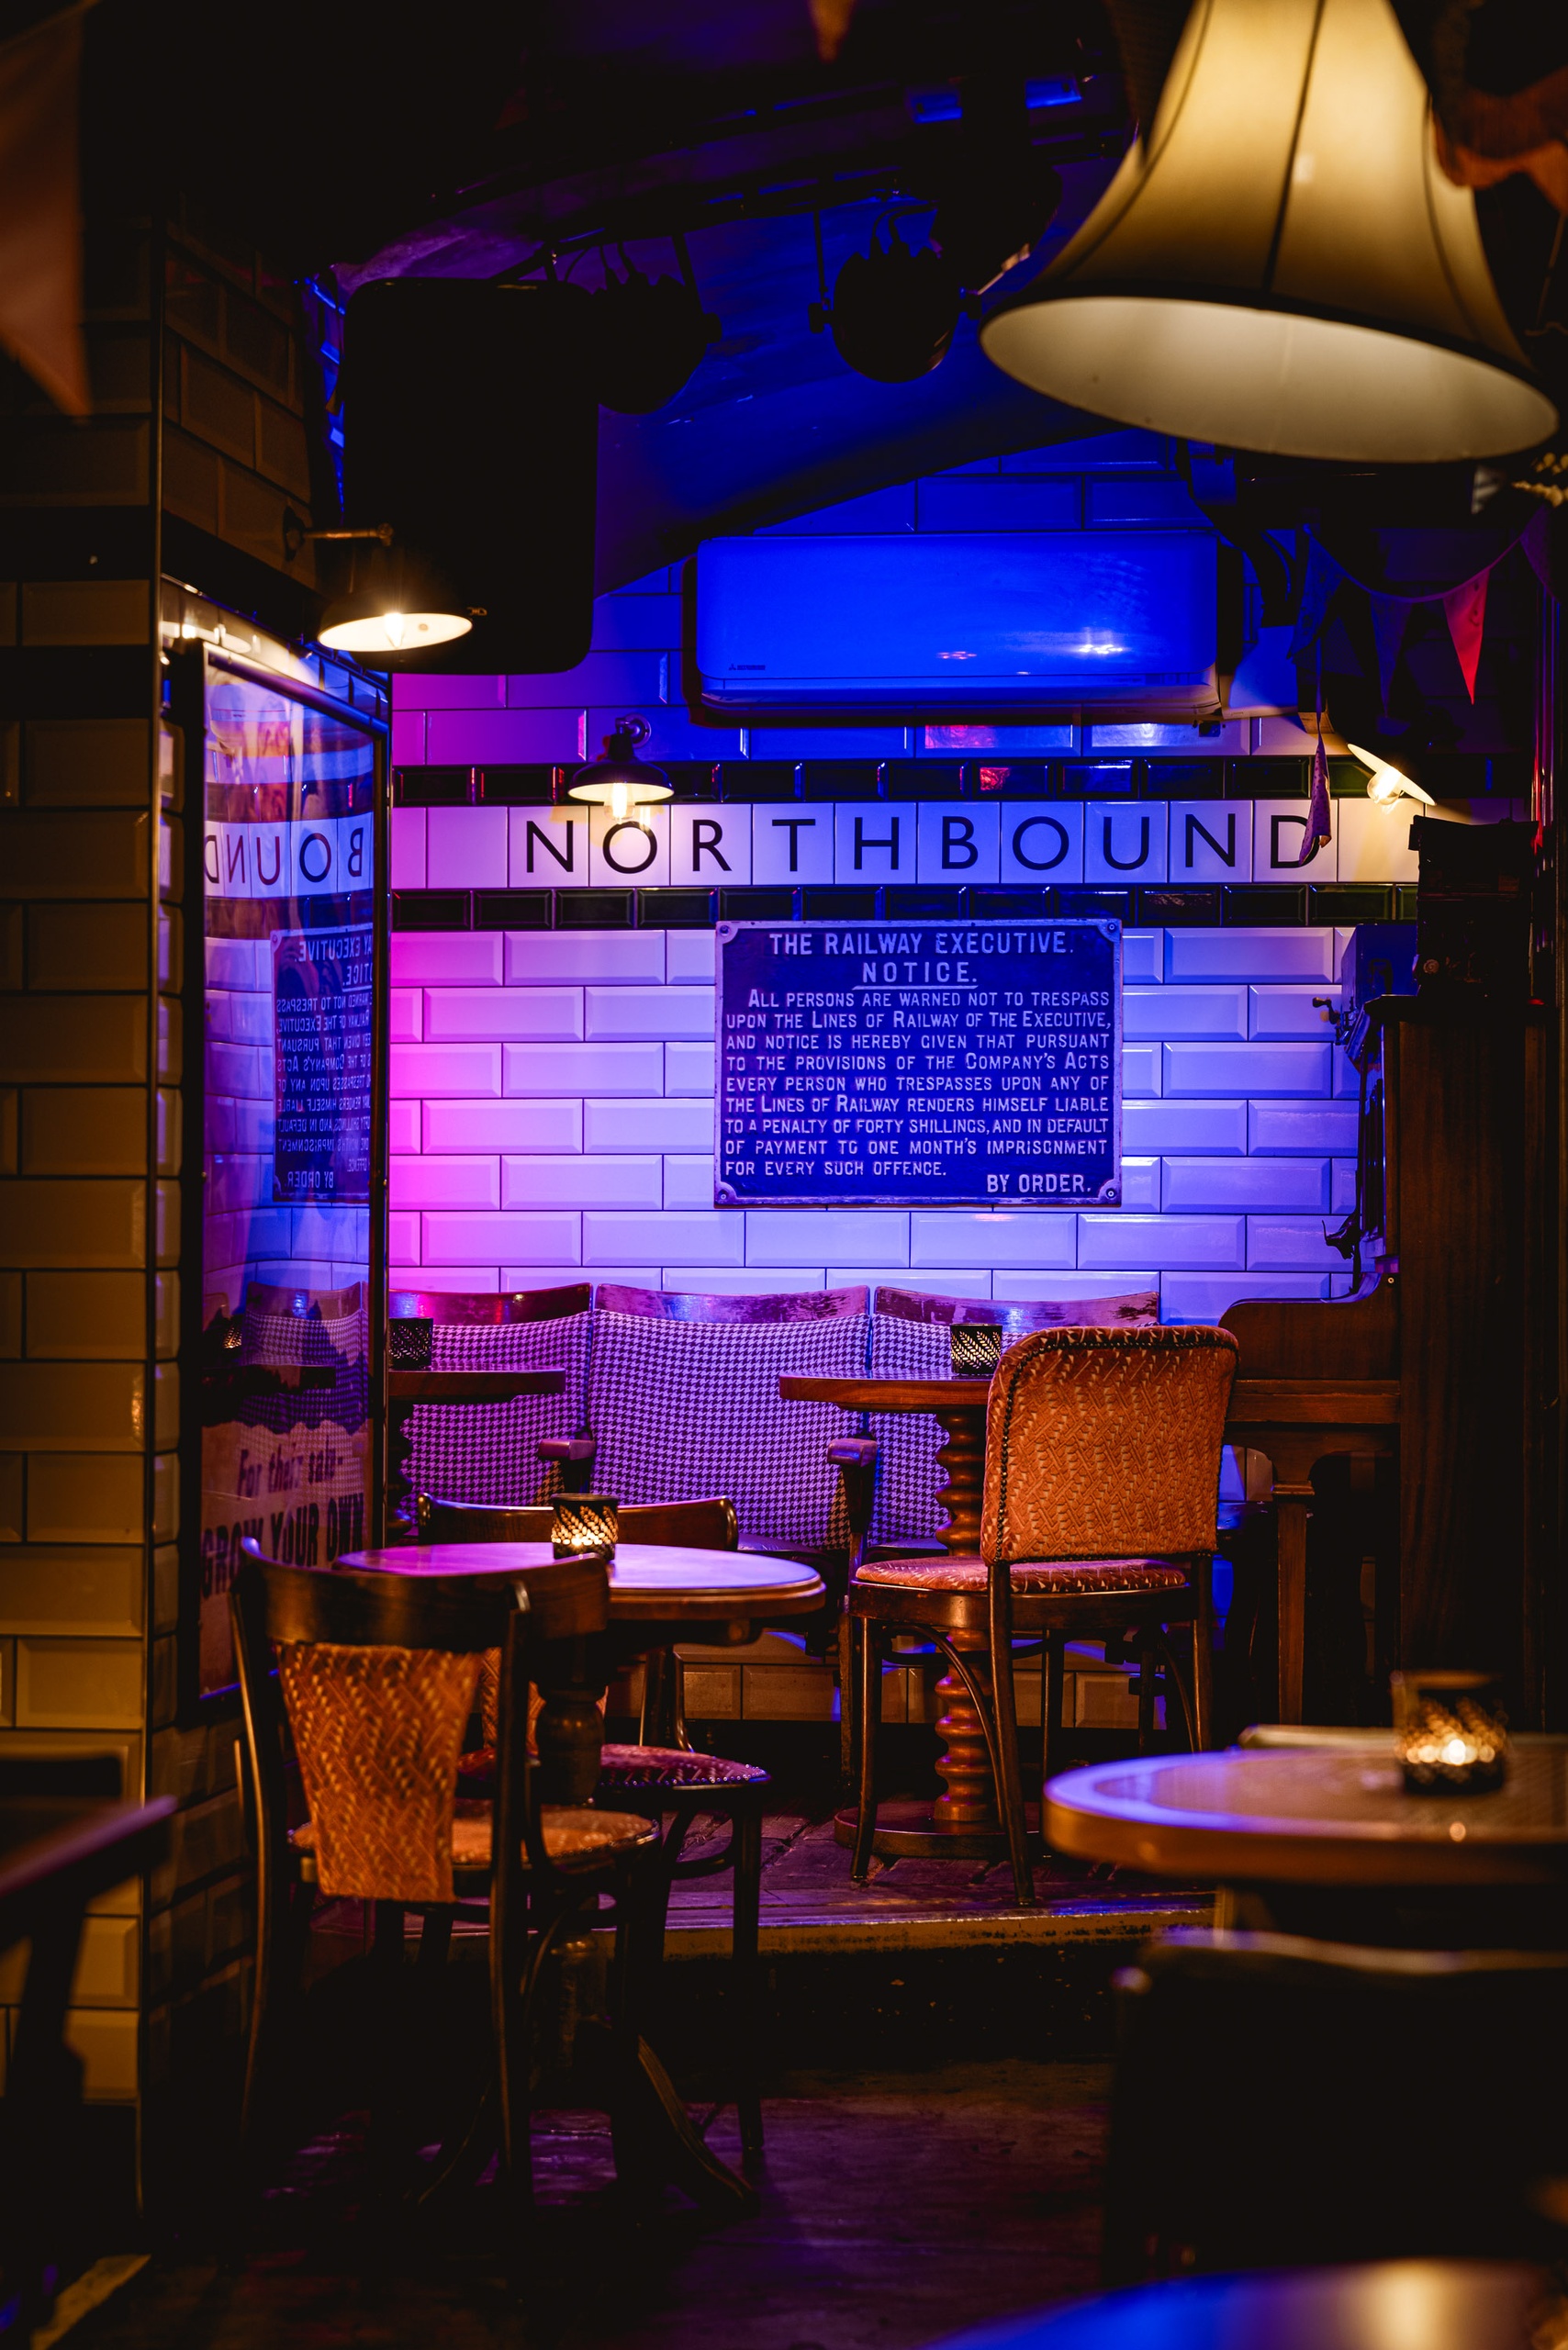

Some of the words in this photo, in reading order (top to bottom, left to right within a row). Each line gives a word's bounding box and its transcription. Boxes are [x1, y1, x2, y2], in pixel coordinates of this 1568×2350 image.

[526, 813, 1320, 874] NORTHBOUND
[768, 933, 812, 956] THE
[824, 933, 923, 955] RAILWAY
[935, 932, 1074, 955] EXECUTIVE.
[862, 961, 977, 983] NOTICE.
[786, 991, 856, 1008] PERSONS
[861, 991, 893, 1007] ARE
[899, 991, 961, 1007] WARNED
[968, 991, 999, 1007] NOT
[1003, 991, 1024, 1006] TO
[1031, 991, 1110, 1006] TRESPASS
[726, 1013, 767, 1029] UPON
[866, 1013, 885, 1028] OF
[966, 1013, 983, 1027] OF
[726, 1035, 756, 1050] AND
[765, 1034, 820, 1050] NOTICE
[828, 1035, 842, 1049] IS
[851, 1034, 912, 1049] HEREBY
[921, 1035, 967, 1049] GIVEN
[977, 1034, 1015, 1049] THAT
[1026, 1033, 1110, 1049] PURSUANT
[726, 1056, 745, 1071] TO
[795, 1056, 886, 1070] PROVISIONS
[896, 1056, 916, 1070] OF
[726, 1077, 778, 1092] EVERY
[785, 1076, 846, 1091] PERSON
[855, 1076, 887, 1091] WHO
[895, 1076, 992, 1091] TRESPASSES
[1001, 1076, 1041, 1091] UPON
[1050, 1076, 1081, 1091] ANY
[1090, 1075, 1109, 1091] OF
[811, 1097, 830, 1113] OF
[907, 1097, 975, 1113] RENDERS
[982, 1097, 1048, 1112] HIMSELF
[1055, 1096, 1109, 1112] LIABLE
[724, 1118, 744, 1134] TO
[748, 1119, 757, 1131] A
[762, 1118, 828, 1134] PENALTY
[833, 1118, 851, 1134] OF
[856, 1118, 904, 1134] FORTY
[1027, 1118, 1042, 1134] IN
[1047, 1117, 1109, 1134] DEFAULT
[725, 1139, 745, 1155] OF
[756, 1139, 828, 1155] PAYMENT
[868, 1140, 899, 1155] ONE
[909, 1137, 977, 1155] MONTH'S
[725, 1160, 755, 1176] FOR
[765, 1160, 815, 1176] EVERY
[824, 1160, 864, 1176] SUCH
[873, 1160, 946, 1176] OFFENCE.
[987, 1174, 1010, 1193] BY
[1018, 1173, 1092, 1193] ORDER.
[237, 1449, 262, 1501] For
[268, 1443, 303, 1494] their
[271, 1503, 319, 1567] YOUR
[326, 1493, 364, 1562] OWN
